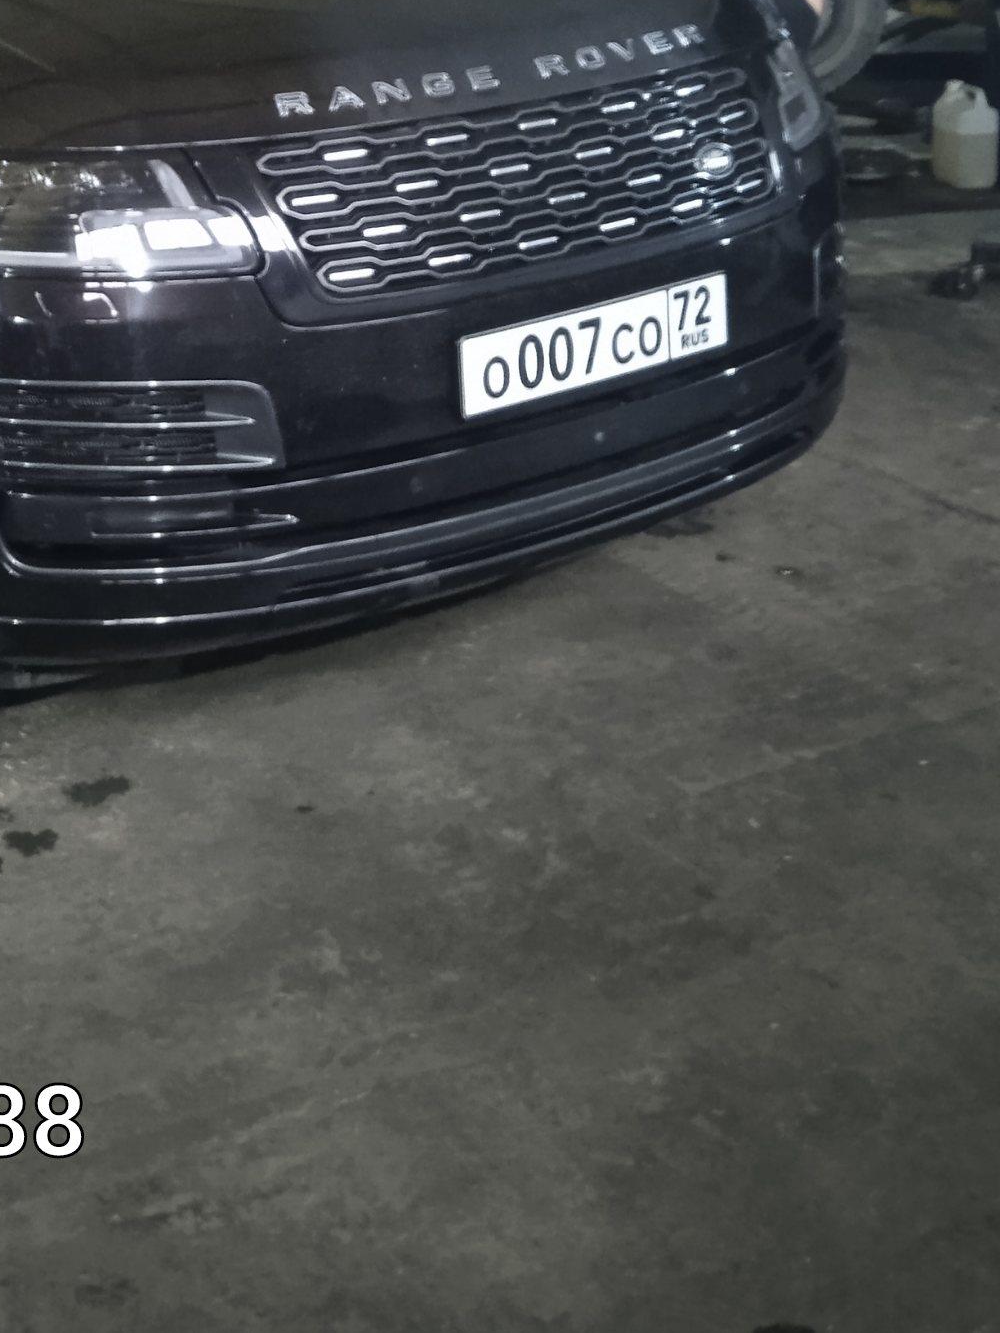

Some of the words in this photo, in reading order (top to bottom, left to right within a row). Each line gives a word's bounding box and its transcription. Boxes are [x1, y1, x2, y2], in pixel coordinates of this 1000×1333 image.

[274, 64, 500, 117] RANGE
[533, 23, 705, 80] ROVER
[673, 285, 712, 331] 72
[681, 330, 709, 349] RUS
